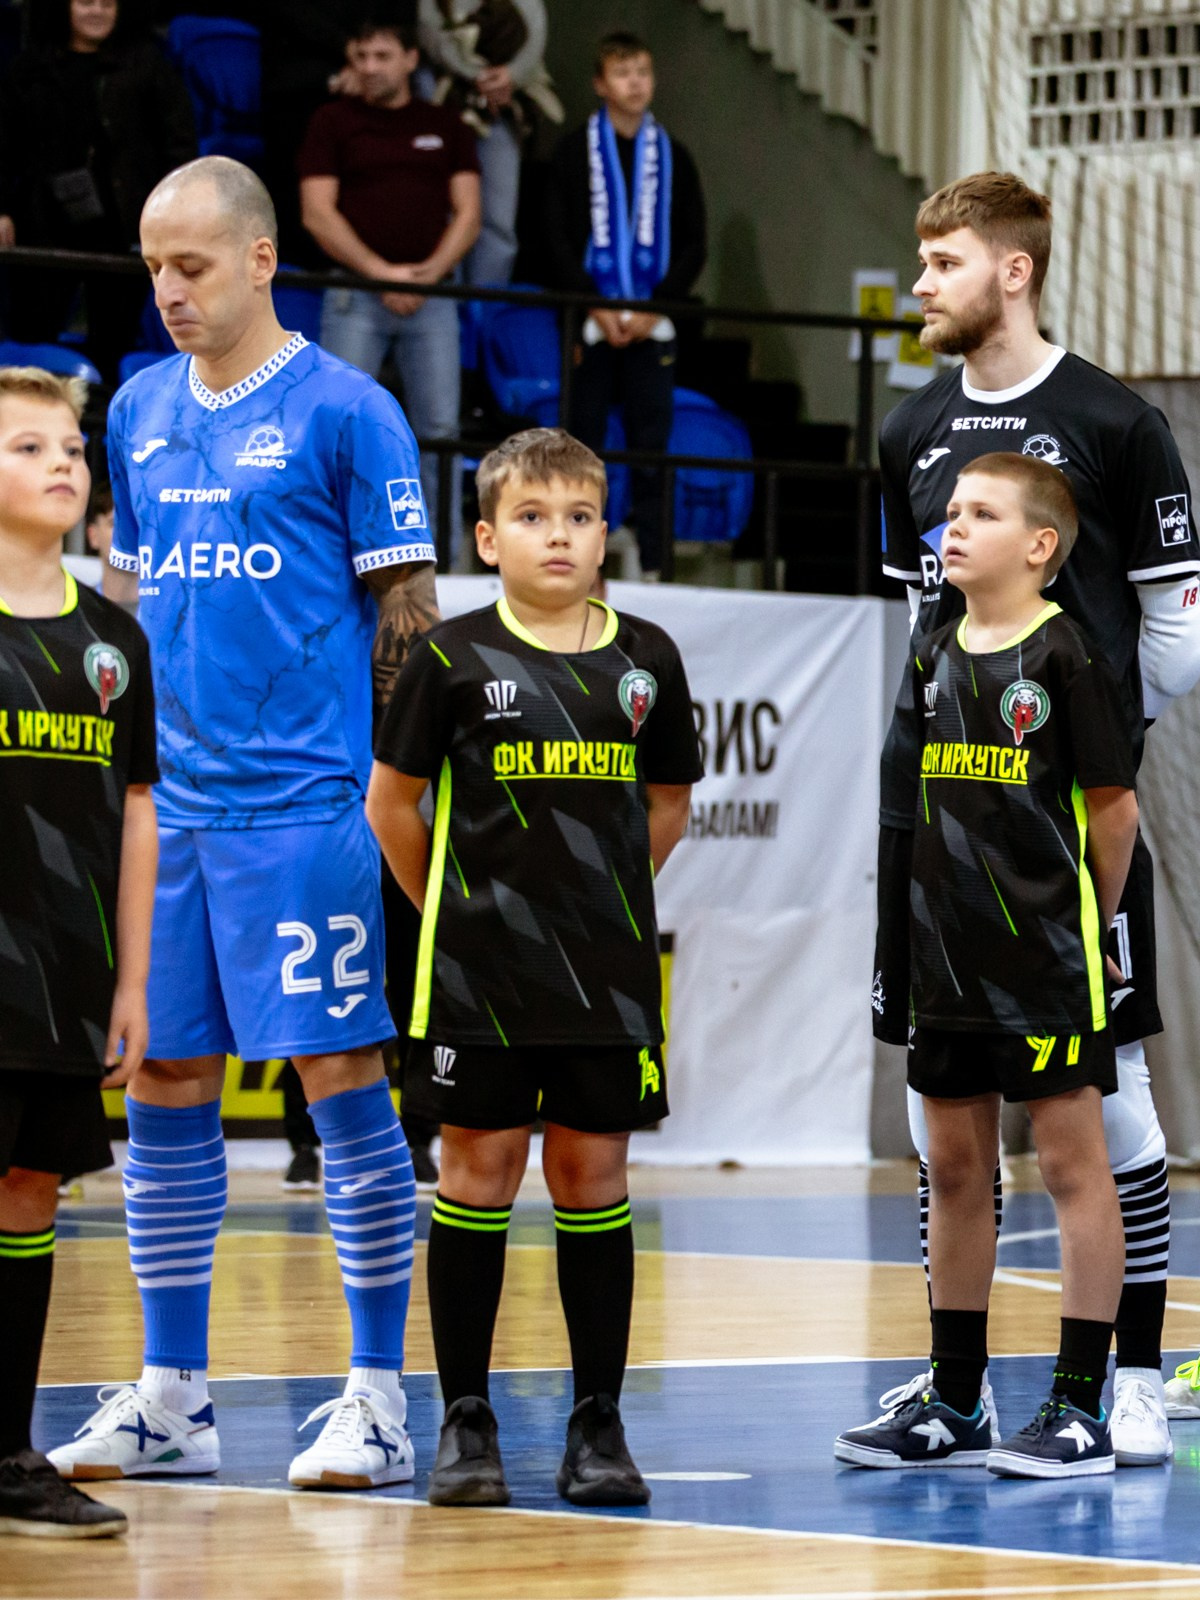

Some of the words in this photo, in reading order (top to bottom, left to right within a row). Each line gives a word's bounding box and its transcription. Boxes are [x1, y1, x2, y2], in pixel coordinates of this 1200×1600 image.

[952, 416, 1027, 431] БЕТСИТИ
[158, 486, 231, 503] БЕТСИТИ
[1181, 586, 1198, 608] 18
[17, 709, 115, 757] ИРКУТСК
[493, 741, 537, 776] ФК
[543, 741, 637, 777] ИРКУТСК
[941, 743, 1030, 780] ИРКУТСК
[276, 914, 370, 995] 22
